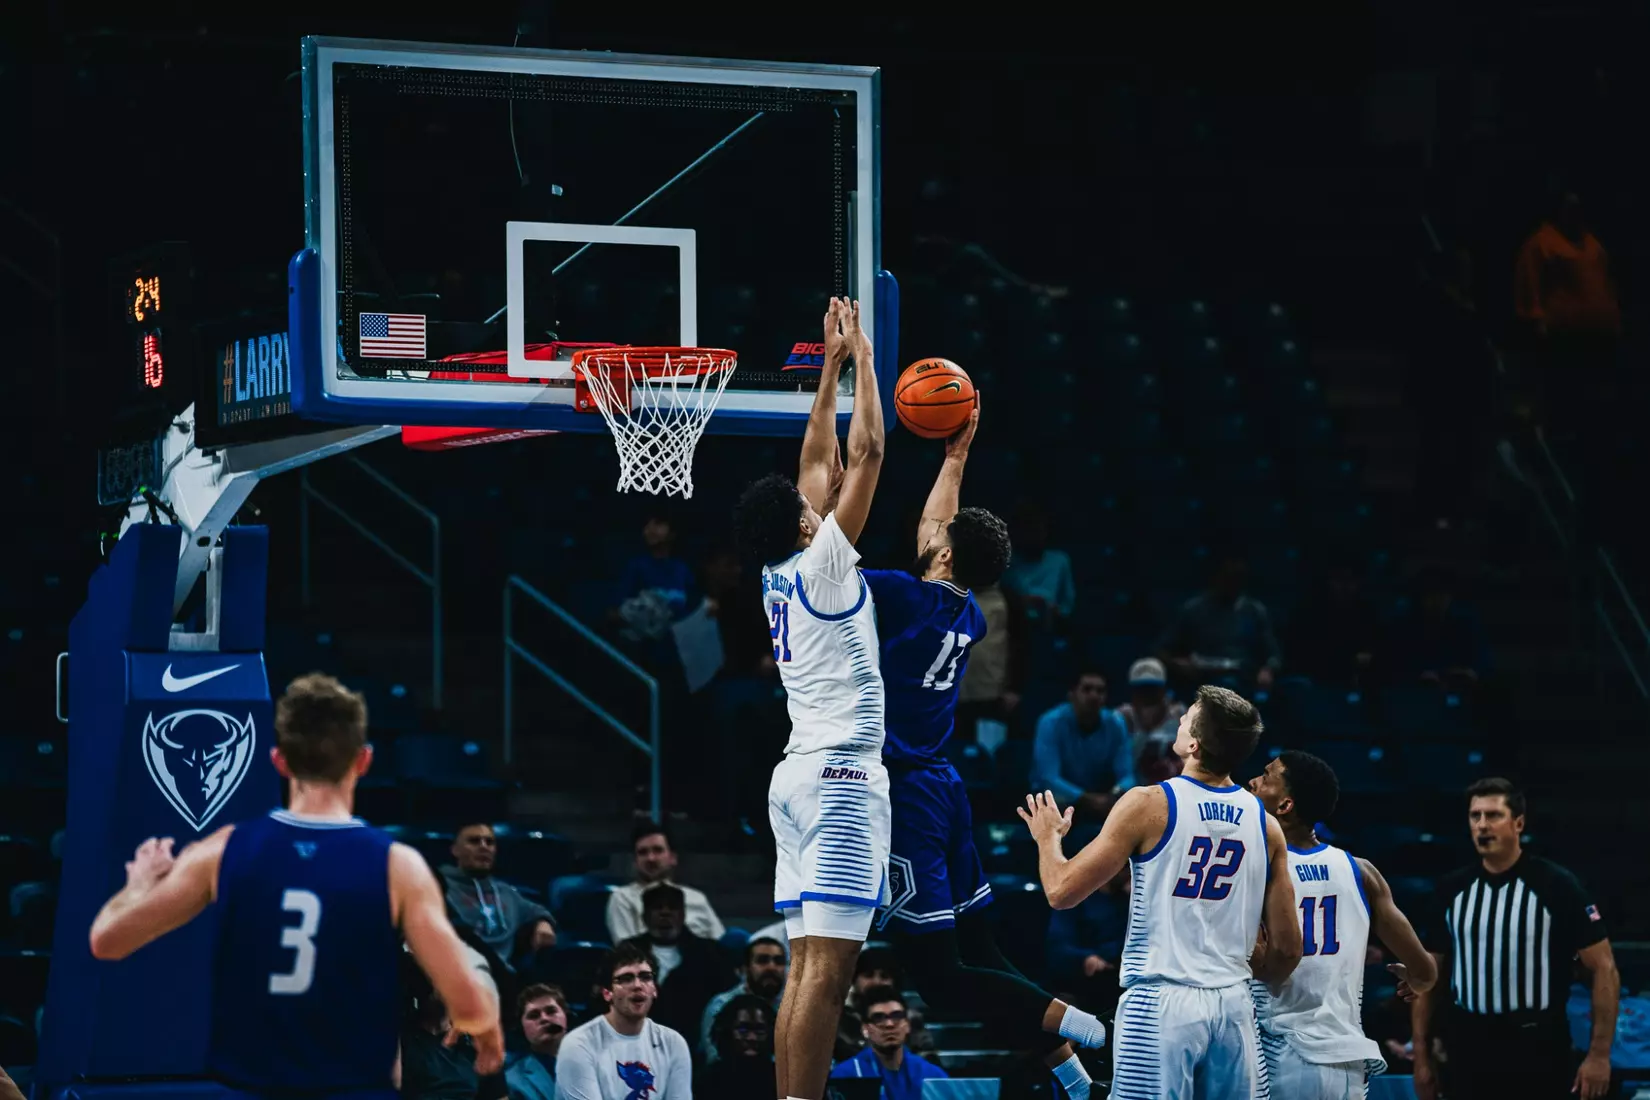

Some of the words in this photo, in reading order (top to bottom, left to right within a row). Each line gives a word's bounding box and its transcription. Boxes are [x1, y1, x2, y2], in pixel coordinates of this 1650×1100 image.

[791, 342, 825, 355] BIG
[770, 601, 792, 663] 21
[921, 630, 972, 691] 13
[1198, 802, 1244, 826] LORENZ
[1172, 835, 1246, 900] 32
[1295, 864, 1330, 882] GUNN
[269, 888, 322, 994] 3
[1299, 894, 1340, 956] 11
